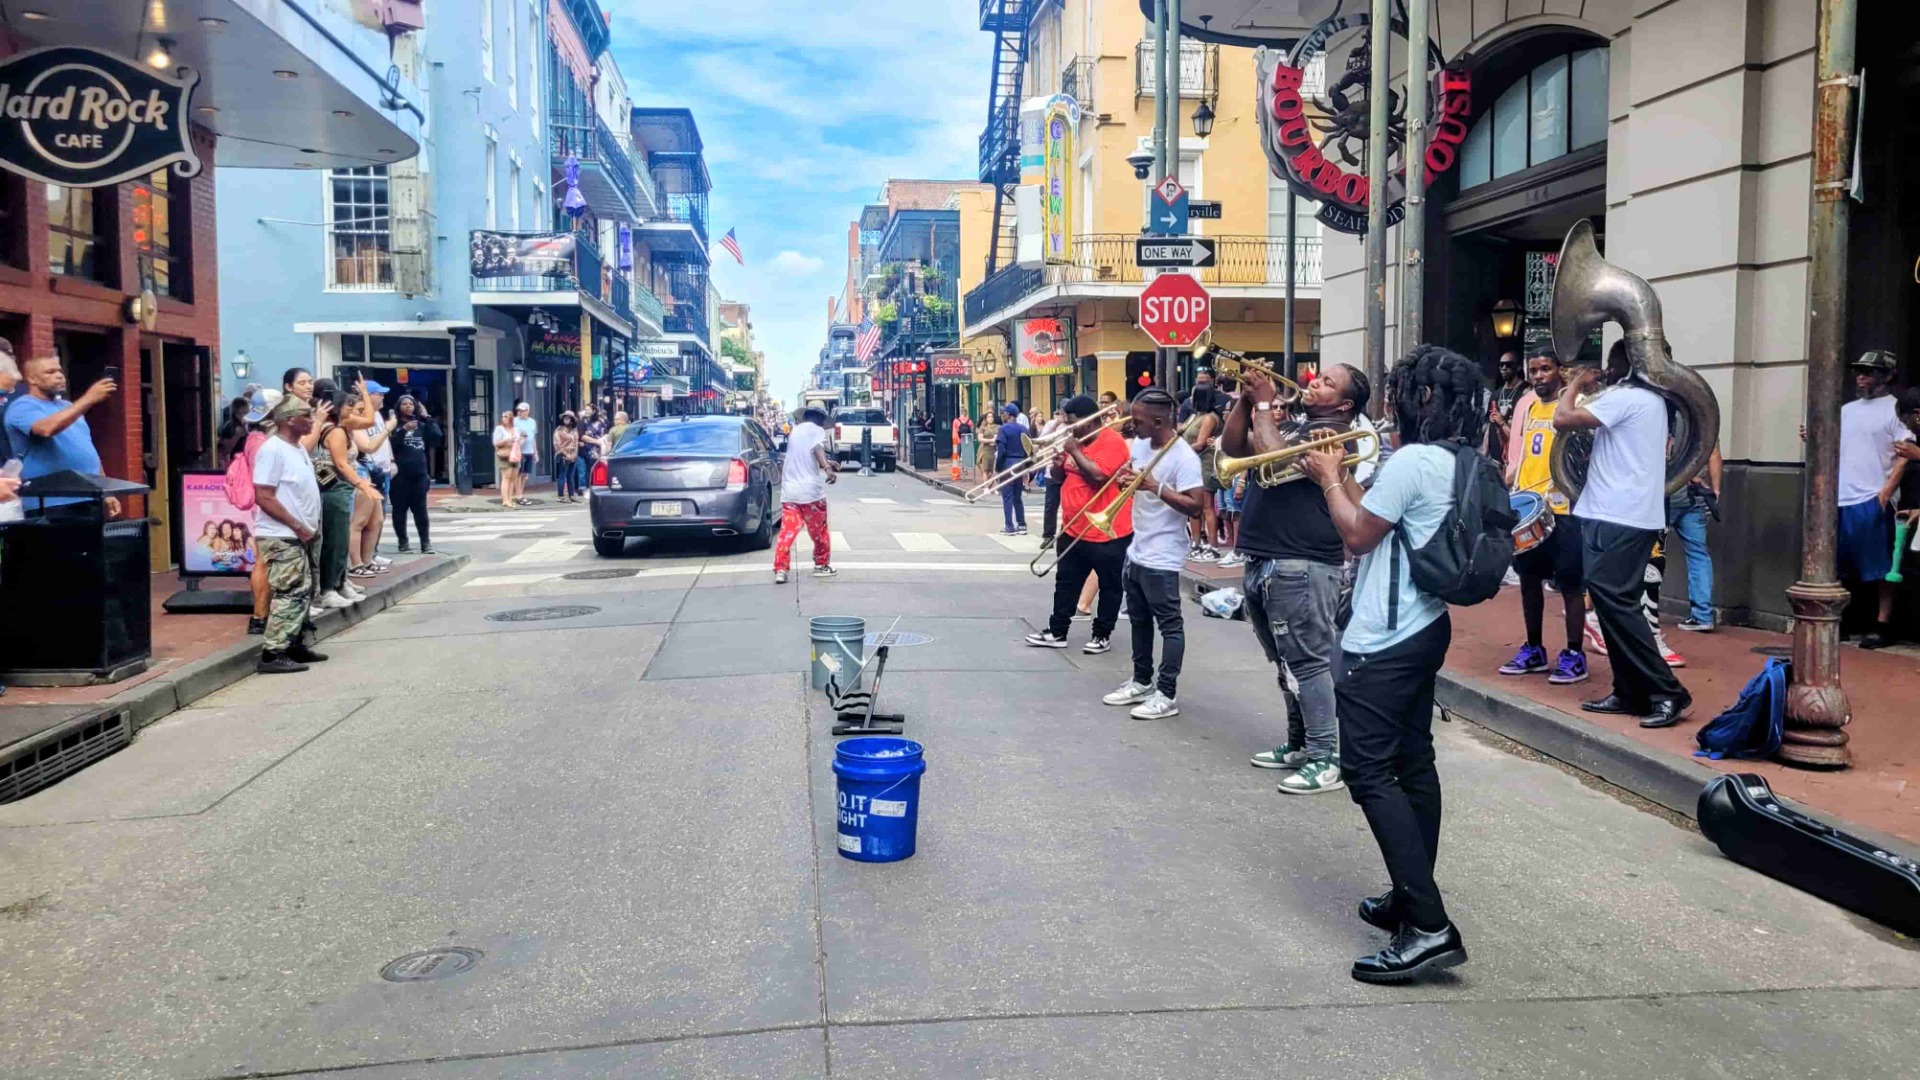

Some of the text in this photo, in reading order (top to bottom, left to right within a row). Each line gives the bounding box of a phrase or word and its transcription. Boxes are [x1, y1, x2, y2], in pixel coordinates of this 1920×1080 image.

[79, 86, 169, 131] Rock
[54, 133, 103, 148] CAFE
[1050, 119, 1064, 252] GATEWAY
[1144, 247, 1193, 259] ONE WAY
[1144, 296, 1206, 324] STOP
[531, 340, 582, 358] MANG
[1219, 348, 1237, 360] GOAT
[1530, 432, 1544, 456] 8
[851, 794, 868, 811] IT
[838, 808, 868, 828] IGHT
